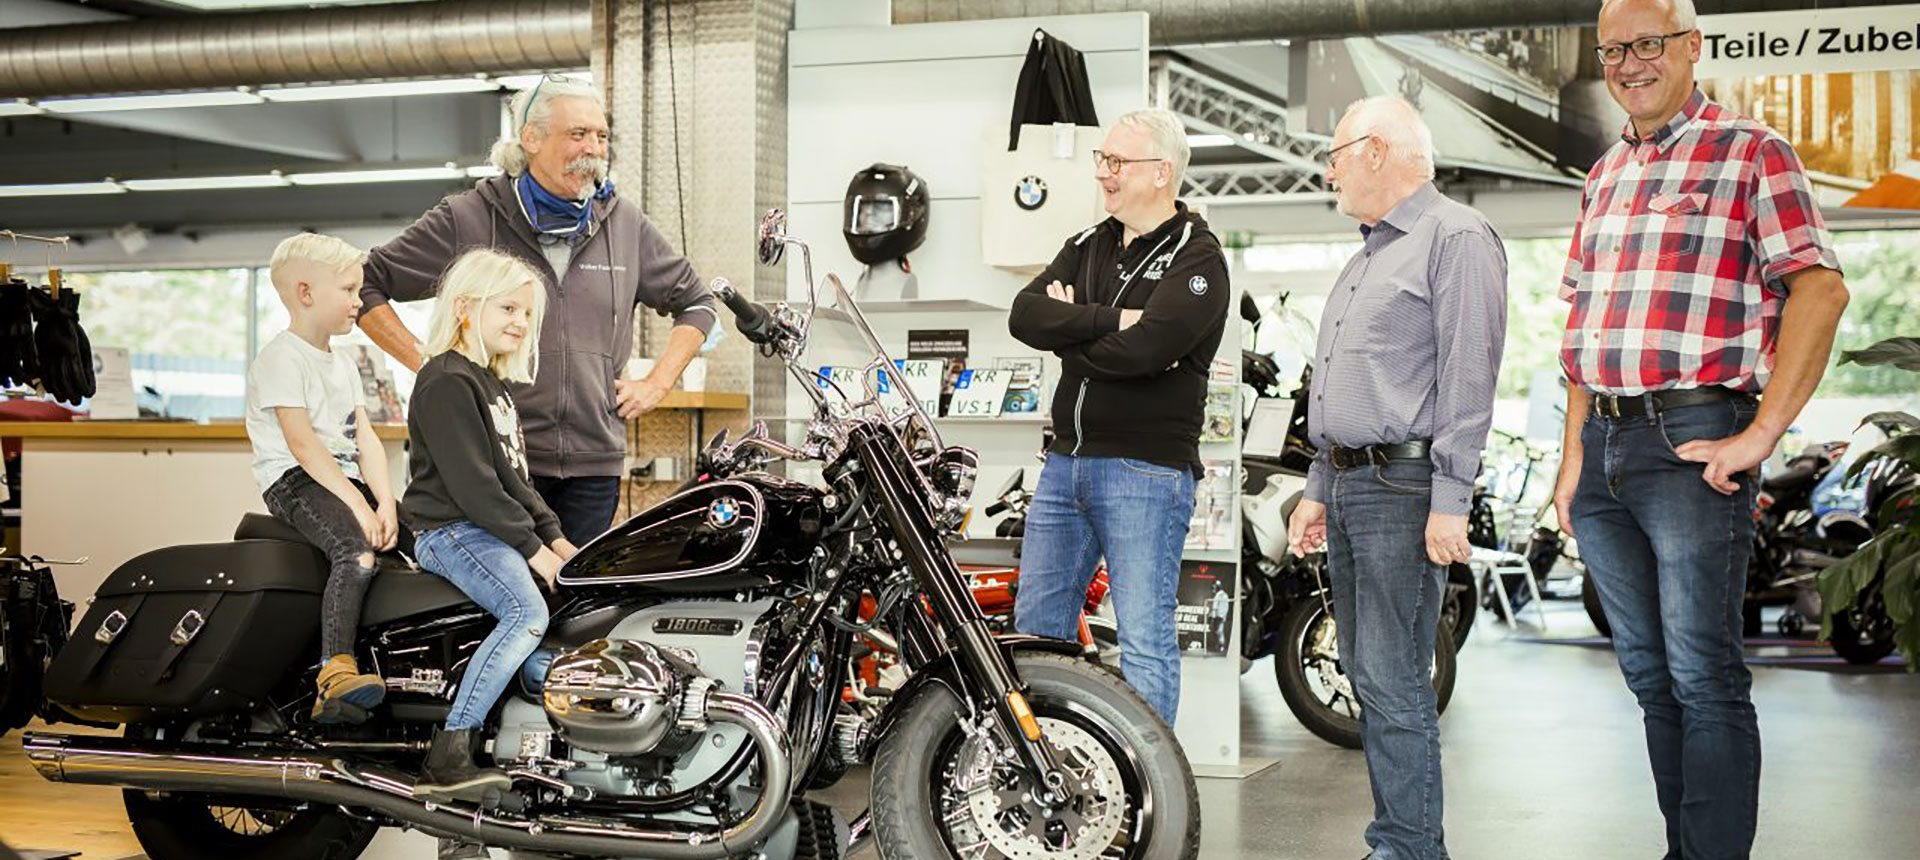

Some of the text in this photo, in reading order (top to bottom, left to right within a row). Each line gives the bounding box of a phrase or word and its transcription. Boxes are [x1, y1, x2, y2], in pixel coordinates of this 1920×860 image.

[1703, 31, 1790, 59] Teile
[832, 368, 854, 381] KR
[905, 361, 928, 376] KR
[973, 370, 998, 382] KR
[957, 400, 980, 413] VS
